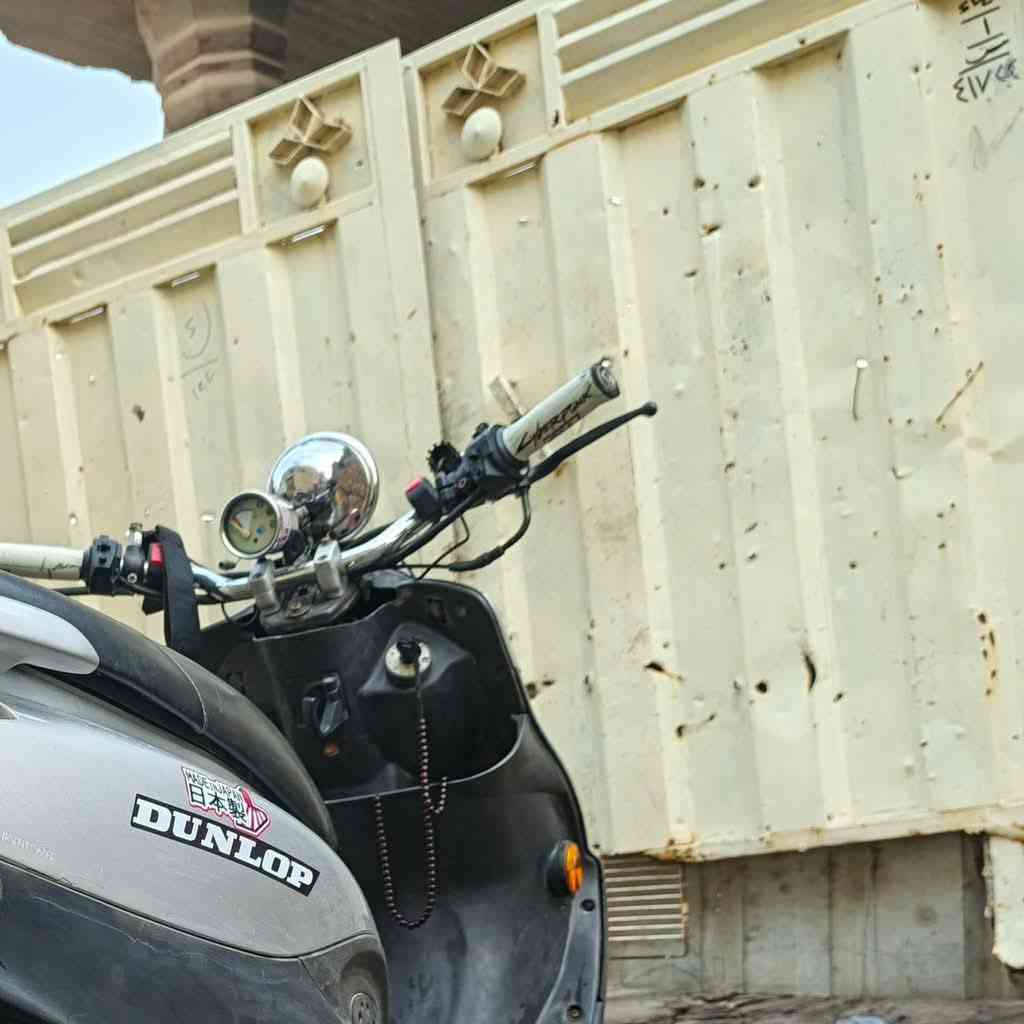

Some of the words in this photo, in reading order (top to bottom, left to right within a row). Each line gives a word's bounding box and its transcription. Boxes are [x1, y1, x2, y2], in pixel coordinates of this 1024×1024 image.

[190, 783, 247, 823] 日本製
[133, 798, 314, 889] DUNLOP
